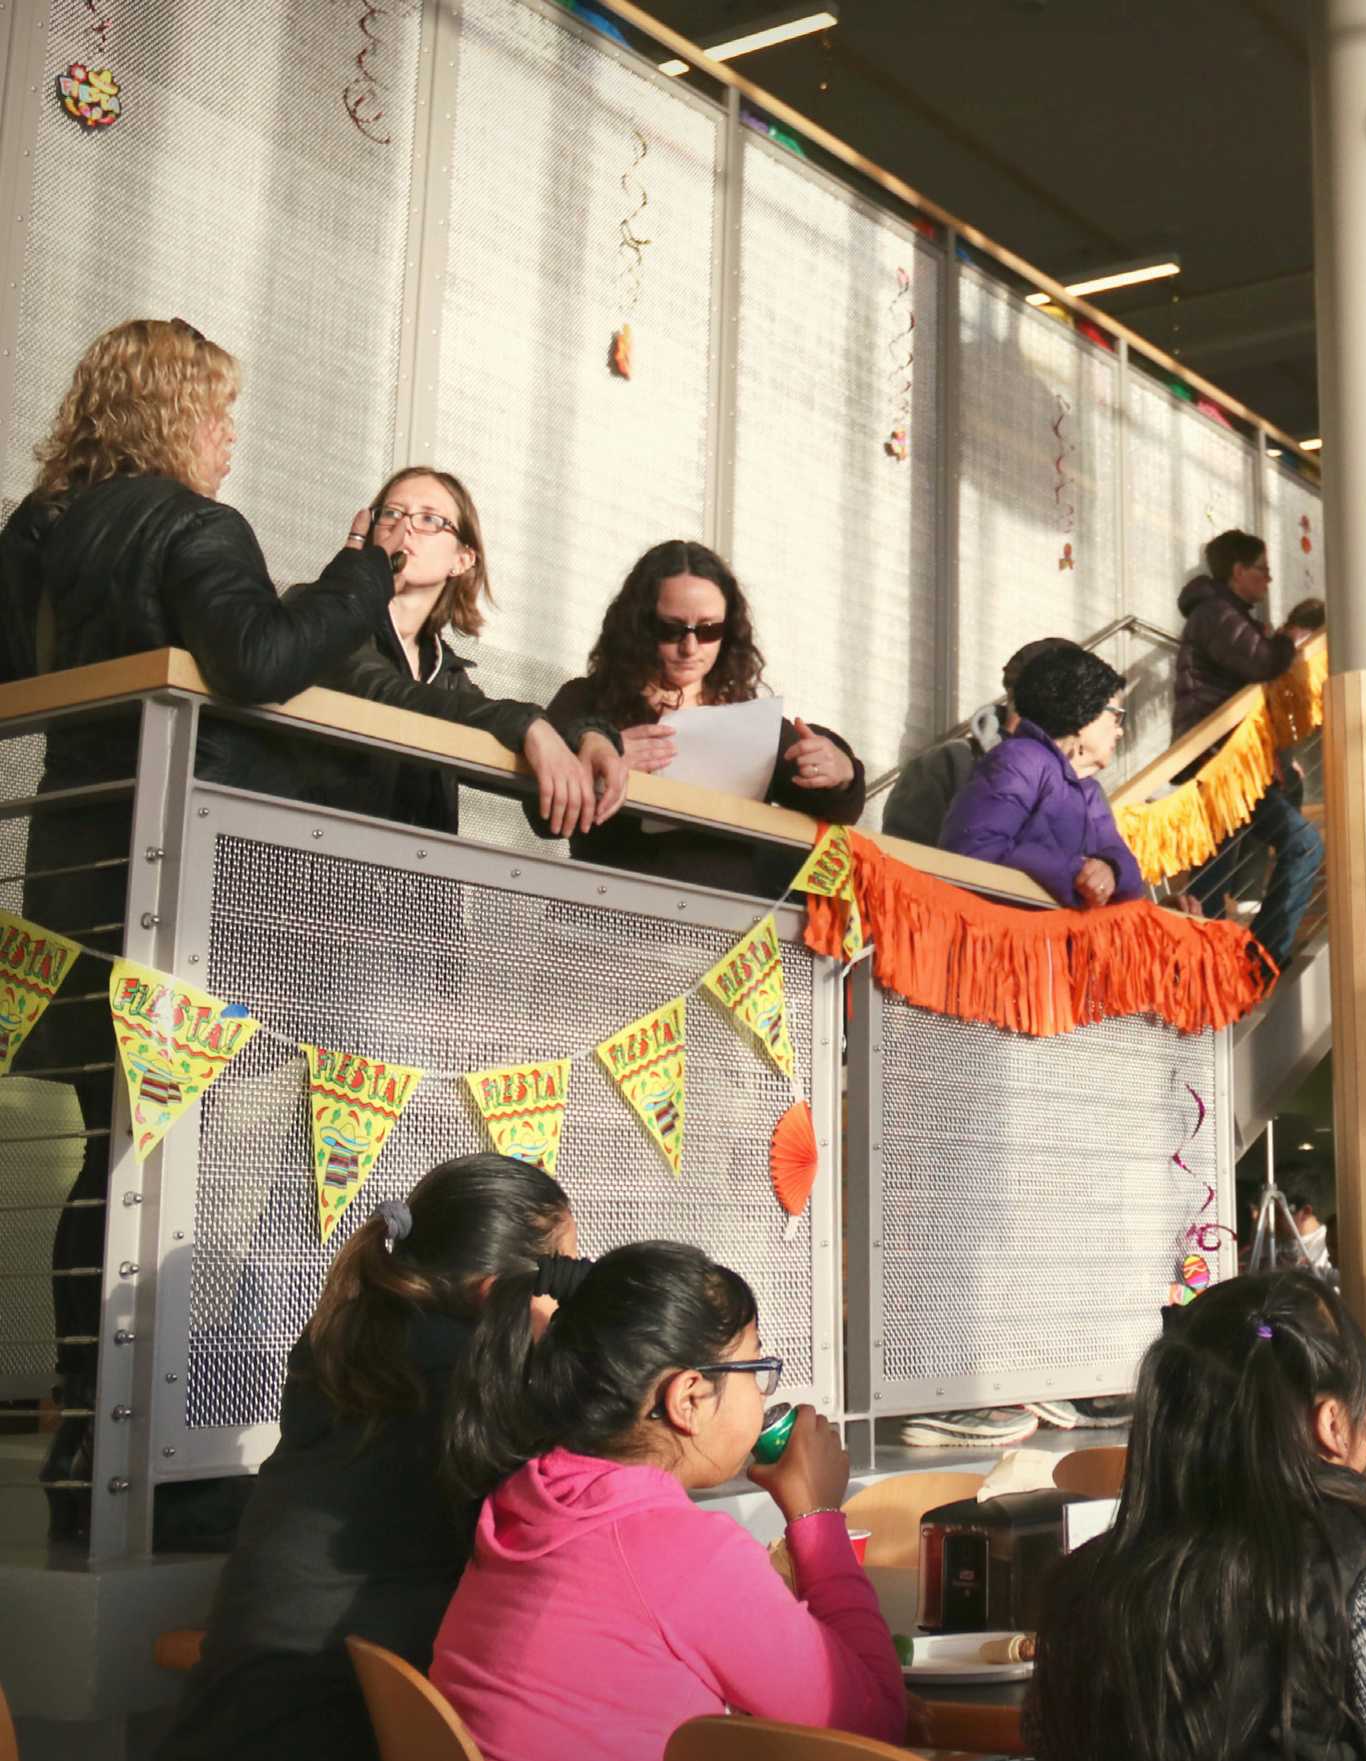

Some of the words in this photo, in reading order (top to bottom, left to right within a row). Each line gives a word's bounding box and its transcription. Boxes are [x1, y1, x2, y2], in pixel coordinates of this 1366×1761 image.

[58, 75, 120, 115] FIESTA
[715, 926, 777, 1004] FIESTA!
[112, 977, 243, 1054] FIESTA!
[607, 1009, 683, 1076] FIESTA!
[313, 1045, 412, 1109] FIESTA!
[479, 1064, 565, 1113] FIESTA!
